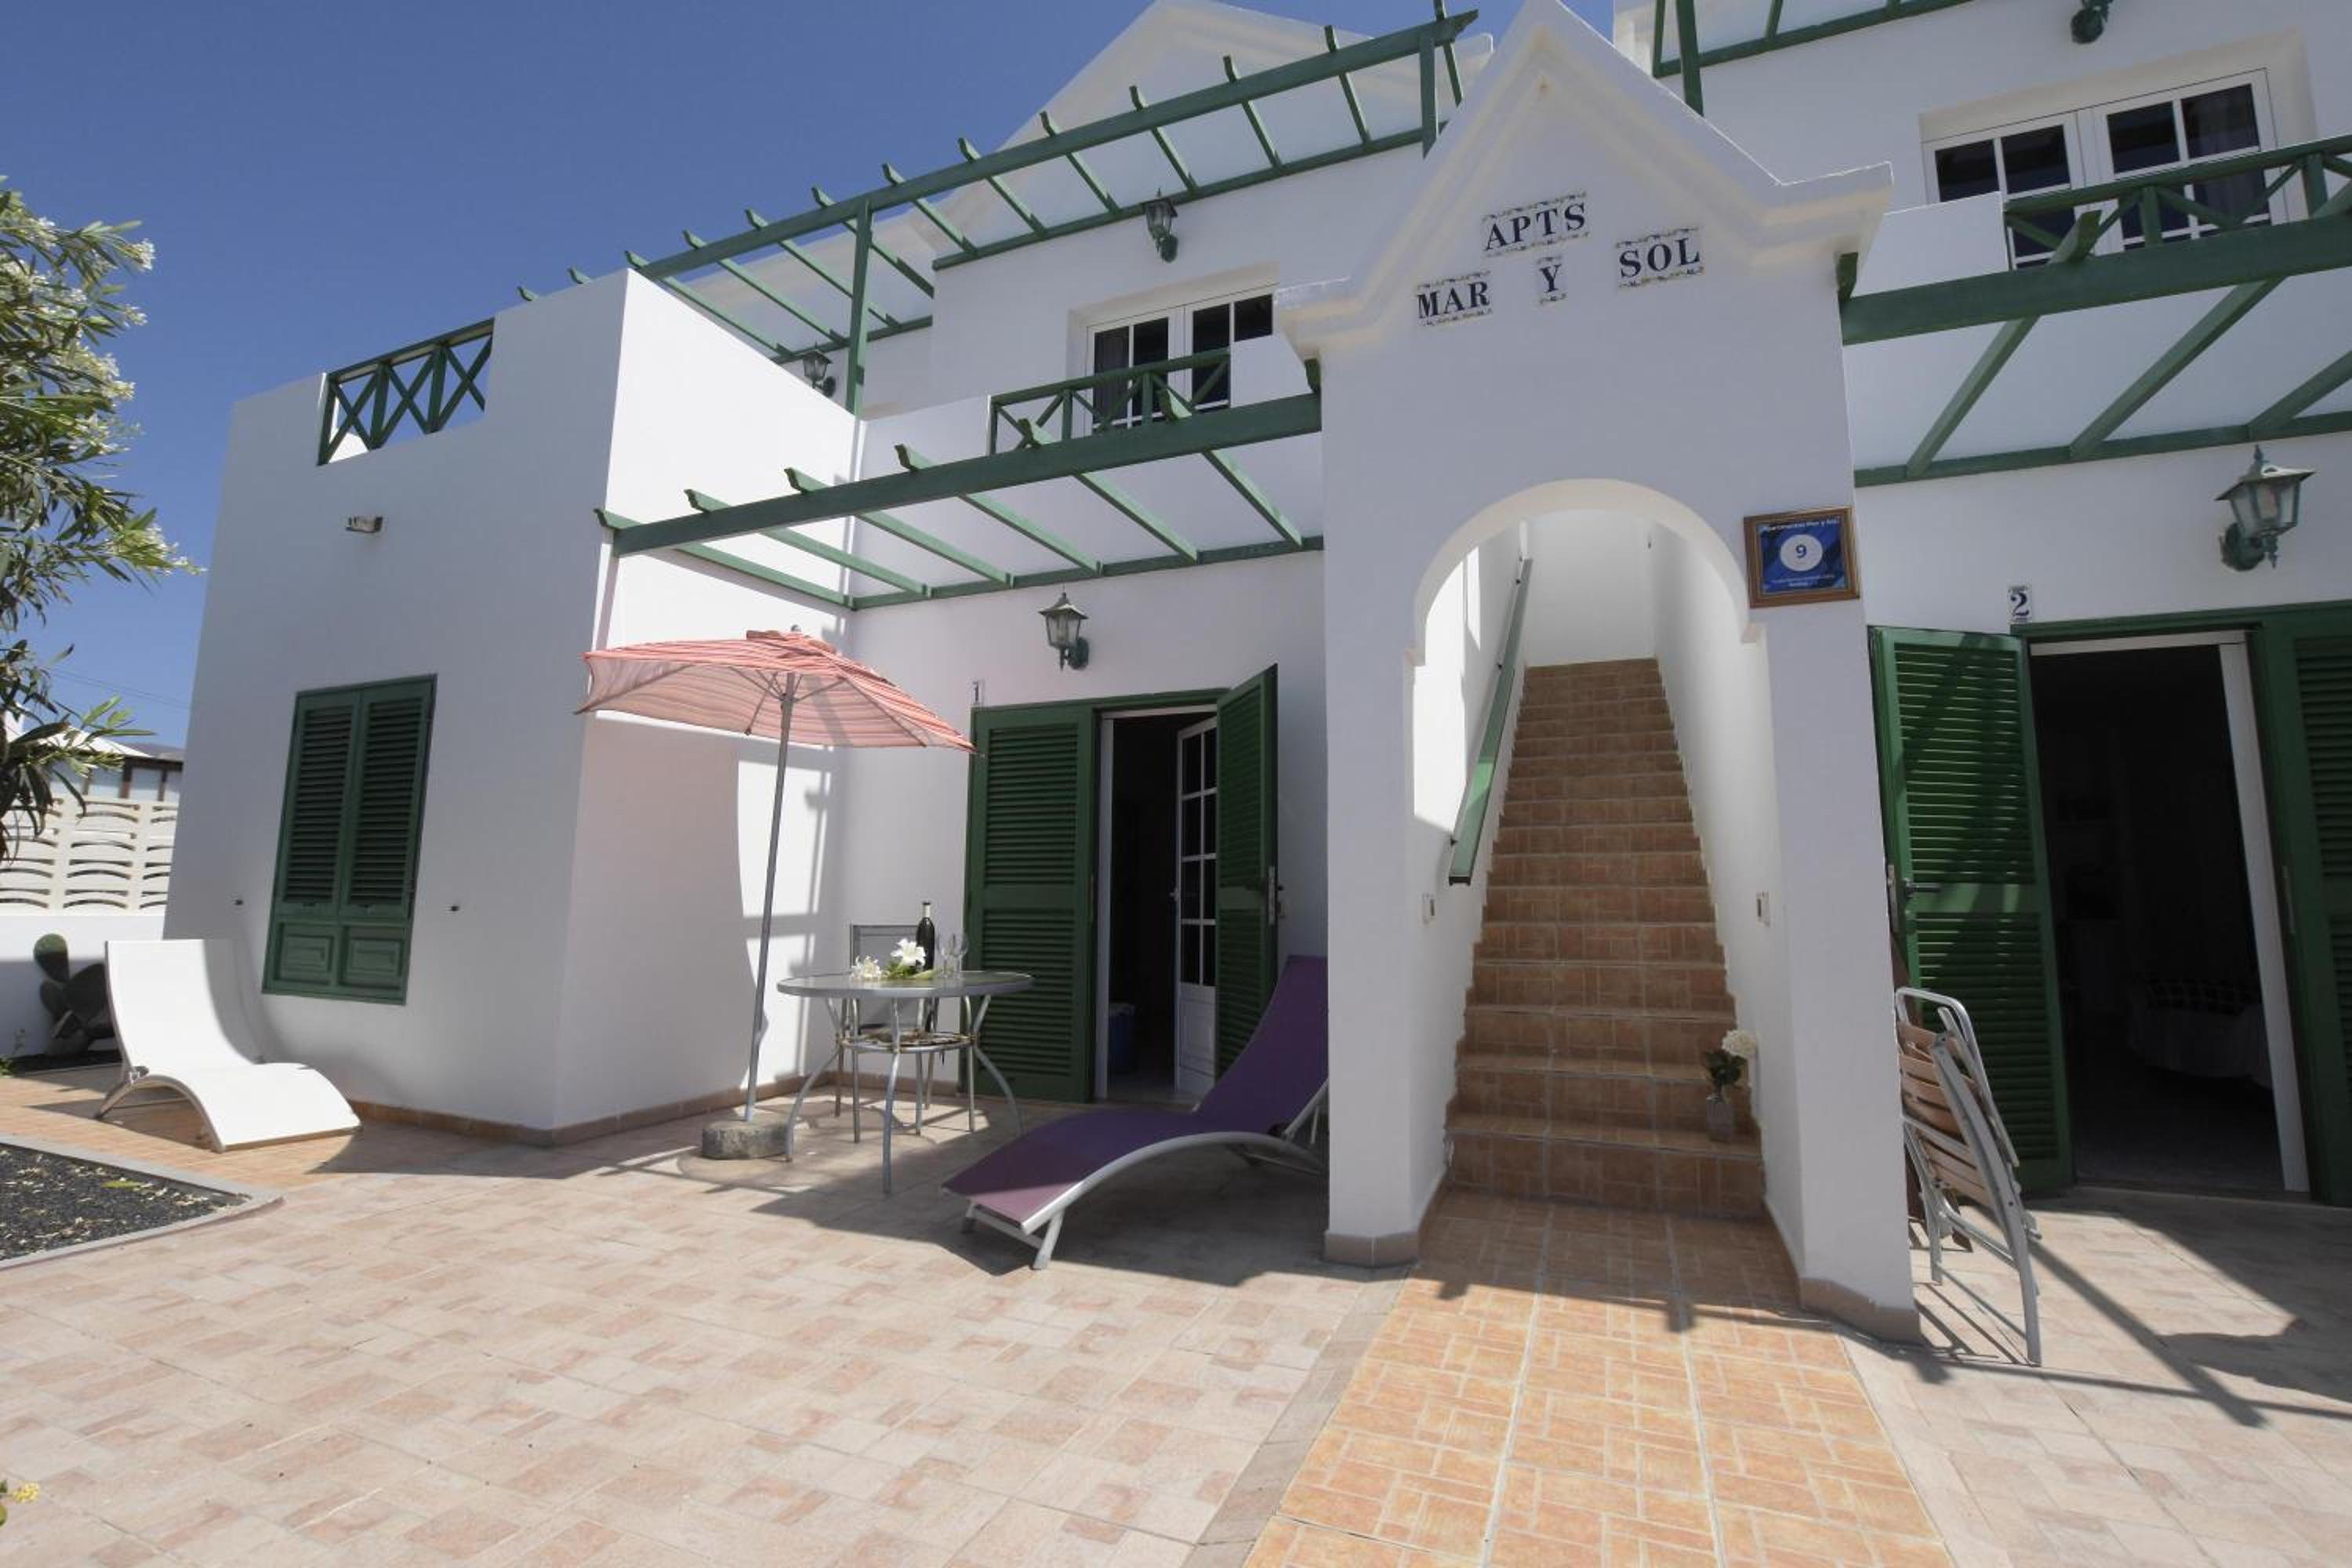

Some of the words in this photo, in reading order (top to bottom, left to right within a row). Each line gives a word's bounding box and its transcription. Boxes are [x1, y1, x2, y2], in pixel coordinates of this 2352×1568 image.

[1483, 202, 1586, 251] APTS
[1417, 281, 1490, 319] MAR
[1540, 264, 1560, 293] Y
[1619, 238, 1700, 278] SOL
[1795, 544, 1807, 559] 9
[2011, 593, 2029, 616] 2
